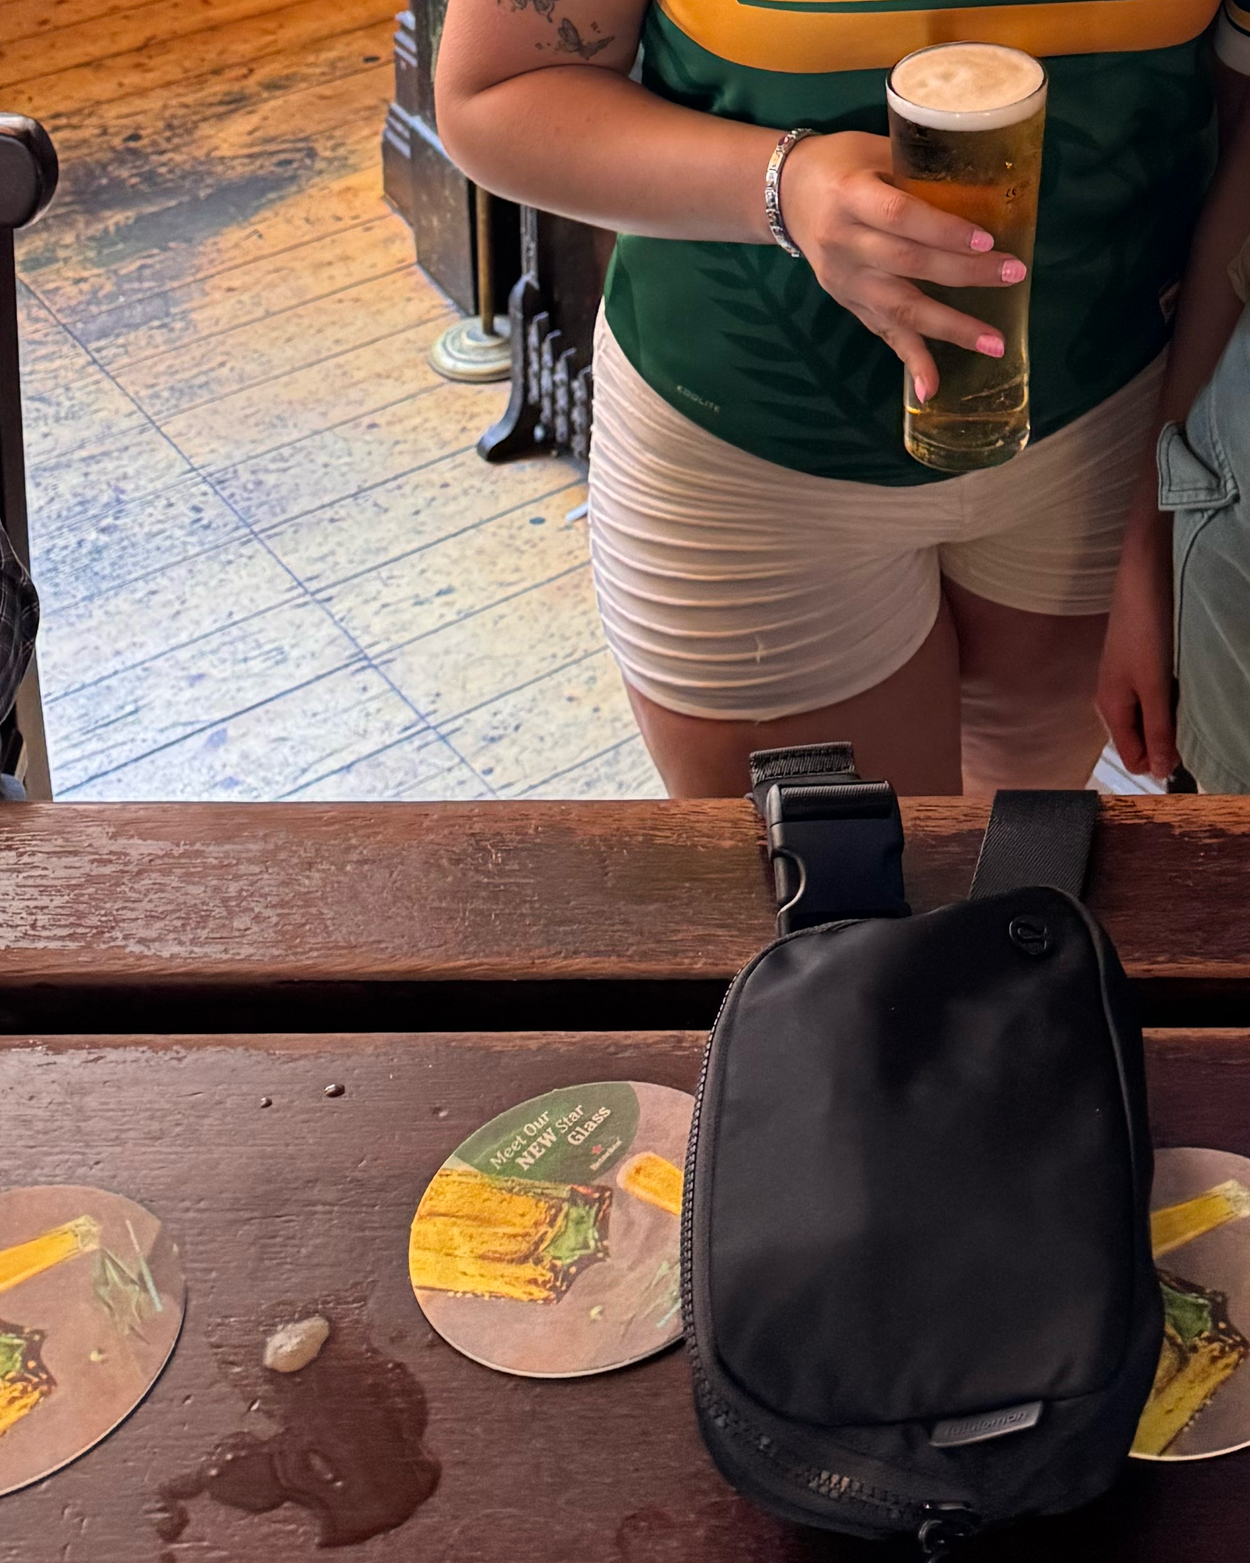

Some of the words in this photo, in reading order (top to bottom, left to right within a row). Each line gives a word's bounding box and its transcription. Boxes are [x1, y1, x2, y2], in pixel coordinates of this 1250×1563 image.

[489, 1135, 527, 1170] Meet
[523, 1110, 550, 1136] Our
[515, 1127, 558, 1171] NEW
[555, 1104, 584, 1134] Star
[567, 1106, 611, 1146] Glass
